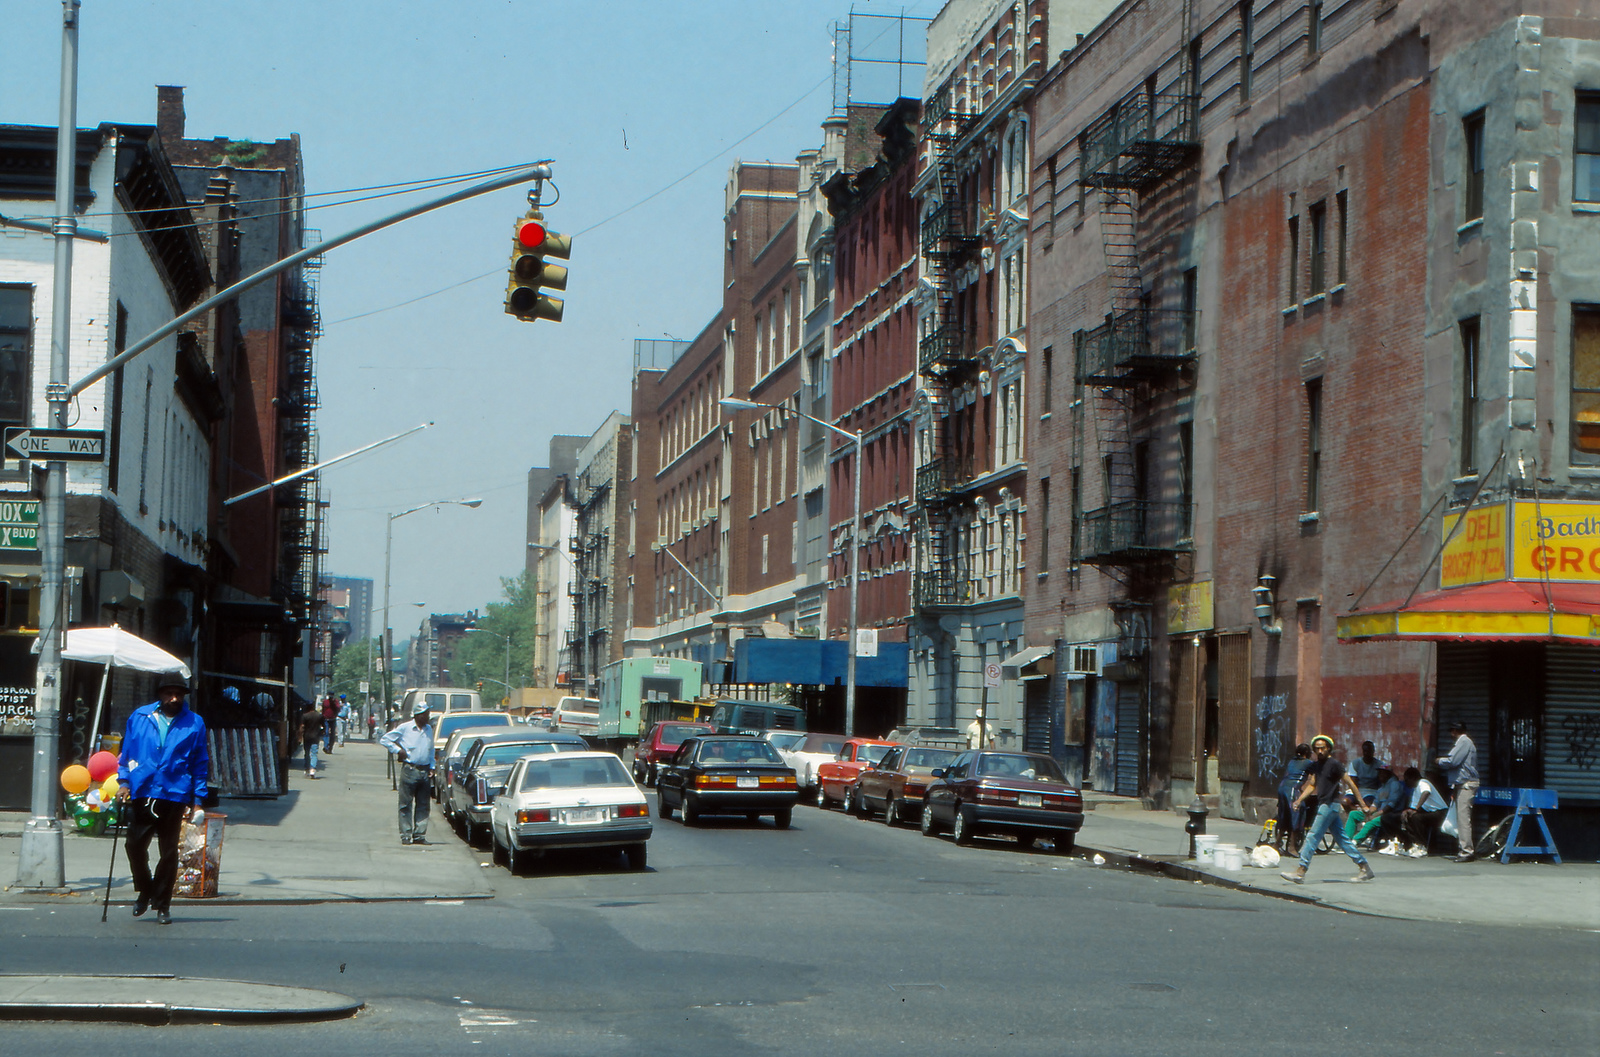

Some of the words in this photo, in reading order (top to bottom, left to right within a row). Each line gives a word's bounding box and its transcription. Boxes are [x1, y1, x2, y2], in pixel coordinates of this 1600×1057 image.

[20, 438, 50, 451] ONE
[69, 439, 98, 452] WAY
[25, 503, 37, 514] AV
[1466, 512, 1501, 543] DELI
[1, 527, 12, 546] X
[12, 527, 36, 539] BLVD
